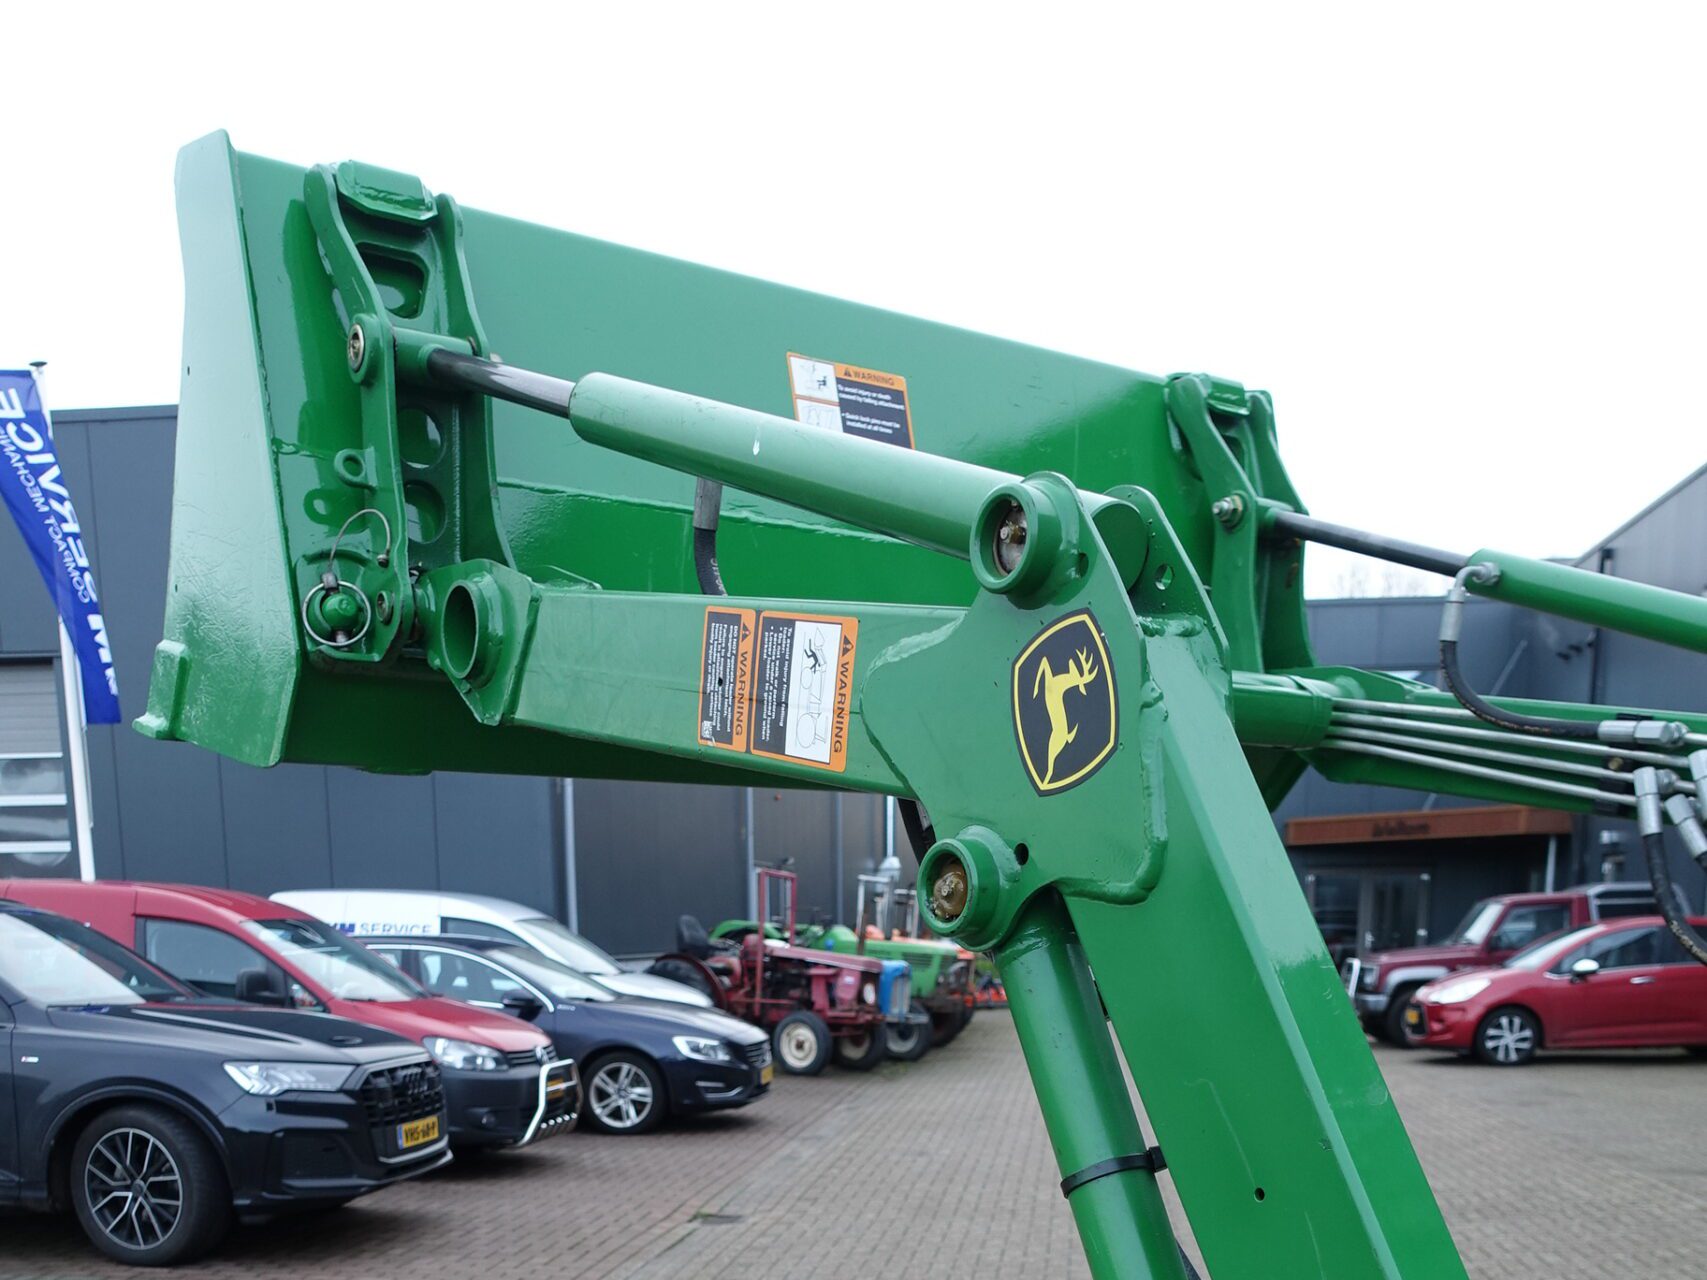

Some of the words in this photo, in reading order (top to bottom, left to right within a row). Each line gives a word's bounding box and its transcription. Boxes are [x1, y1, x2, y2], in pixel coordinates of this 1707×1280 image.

[853, 370, 895, 386] WARNING
[736, 651, 748, 736] WARNING
[834, 661, 849, 753] WARNING
